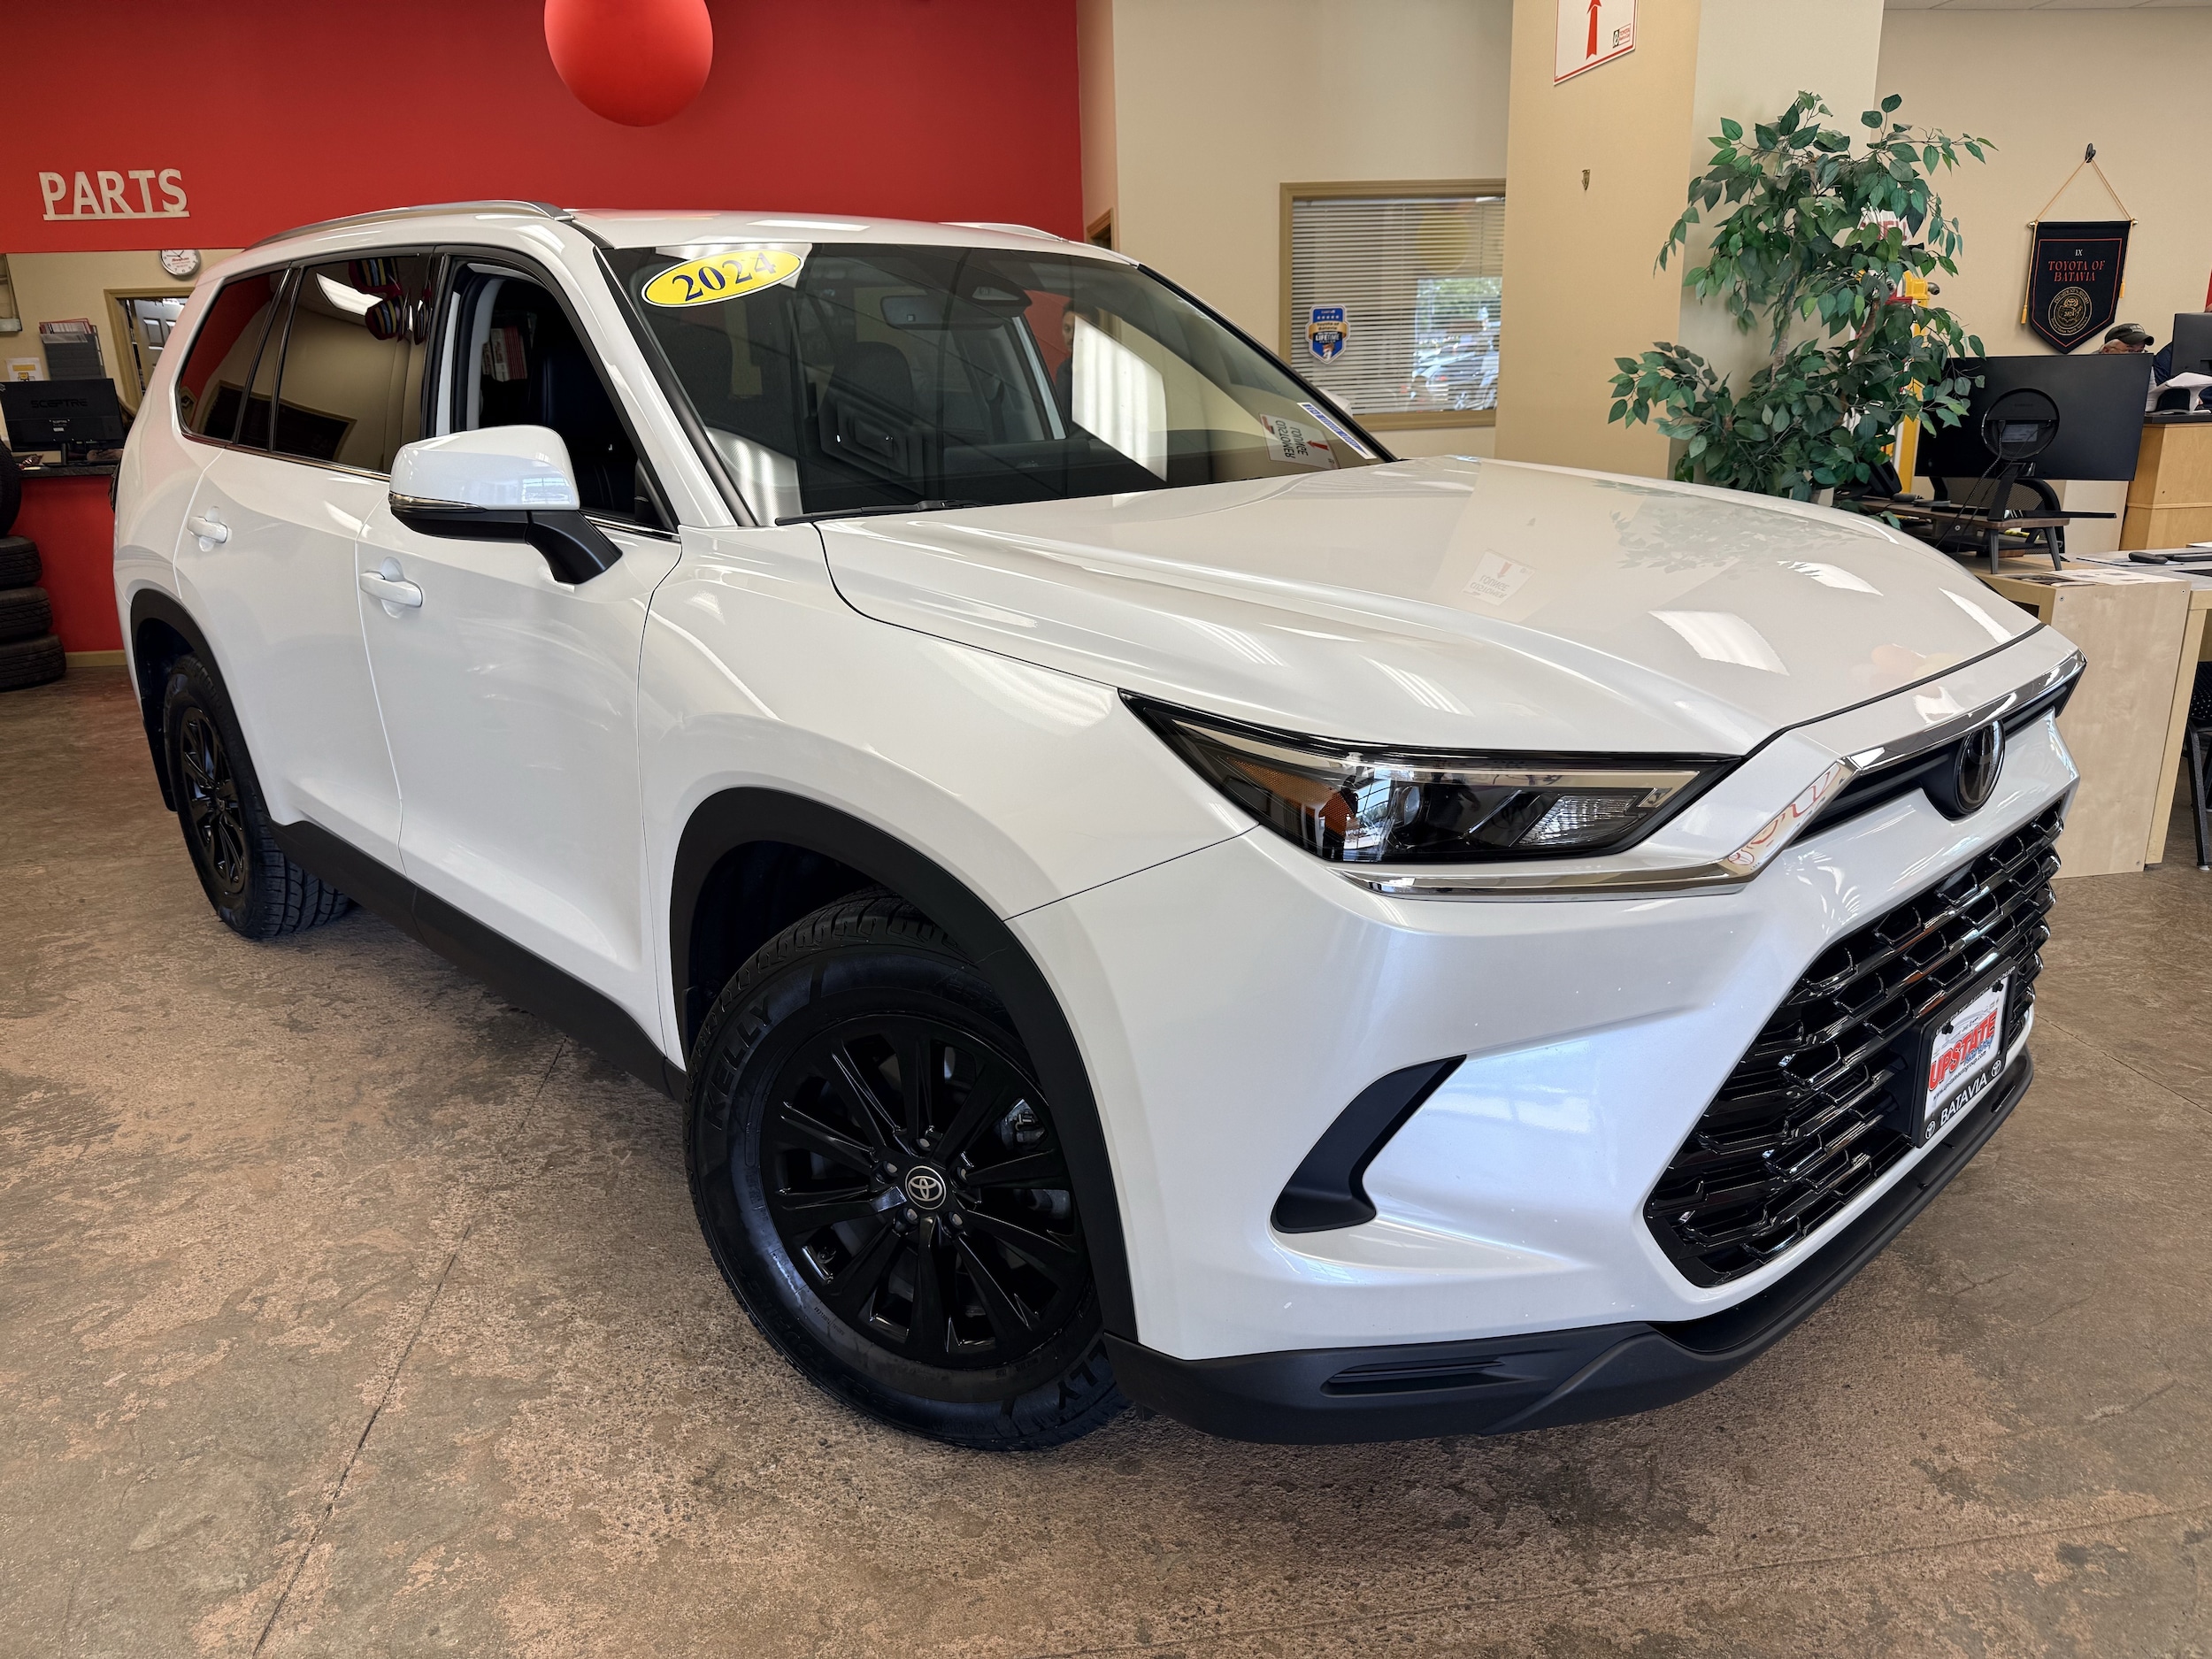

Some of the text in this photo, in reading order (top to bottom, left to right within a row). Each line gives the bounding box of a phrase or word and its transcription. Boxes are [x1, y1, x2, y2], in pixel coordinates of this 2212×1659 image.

[39, 168, 190, 220] PARTS
[672, 252, 776, 301] 2024
[2048, 260, 2105, 271] TOYOTA OF
[2054, 272, 2095, 281] BATAVIA
[31, 398, 88, 408] SCEPTRE
[703, 995, 772, 1133] KELLY
[1928, 1009, 1998, 1092] UPSTATE
[1939, 1072, 1988, 1126] BATAVIA
[1057, 1338, 1110, 1410] LLY
